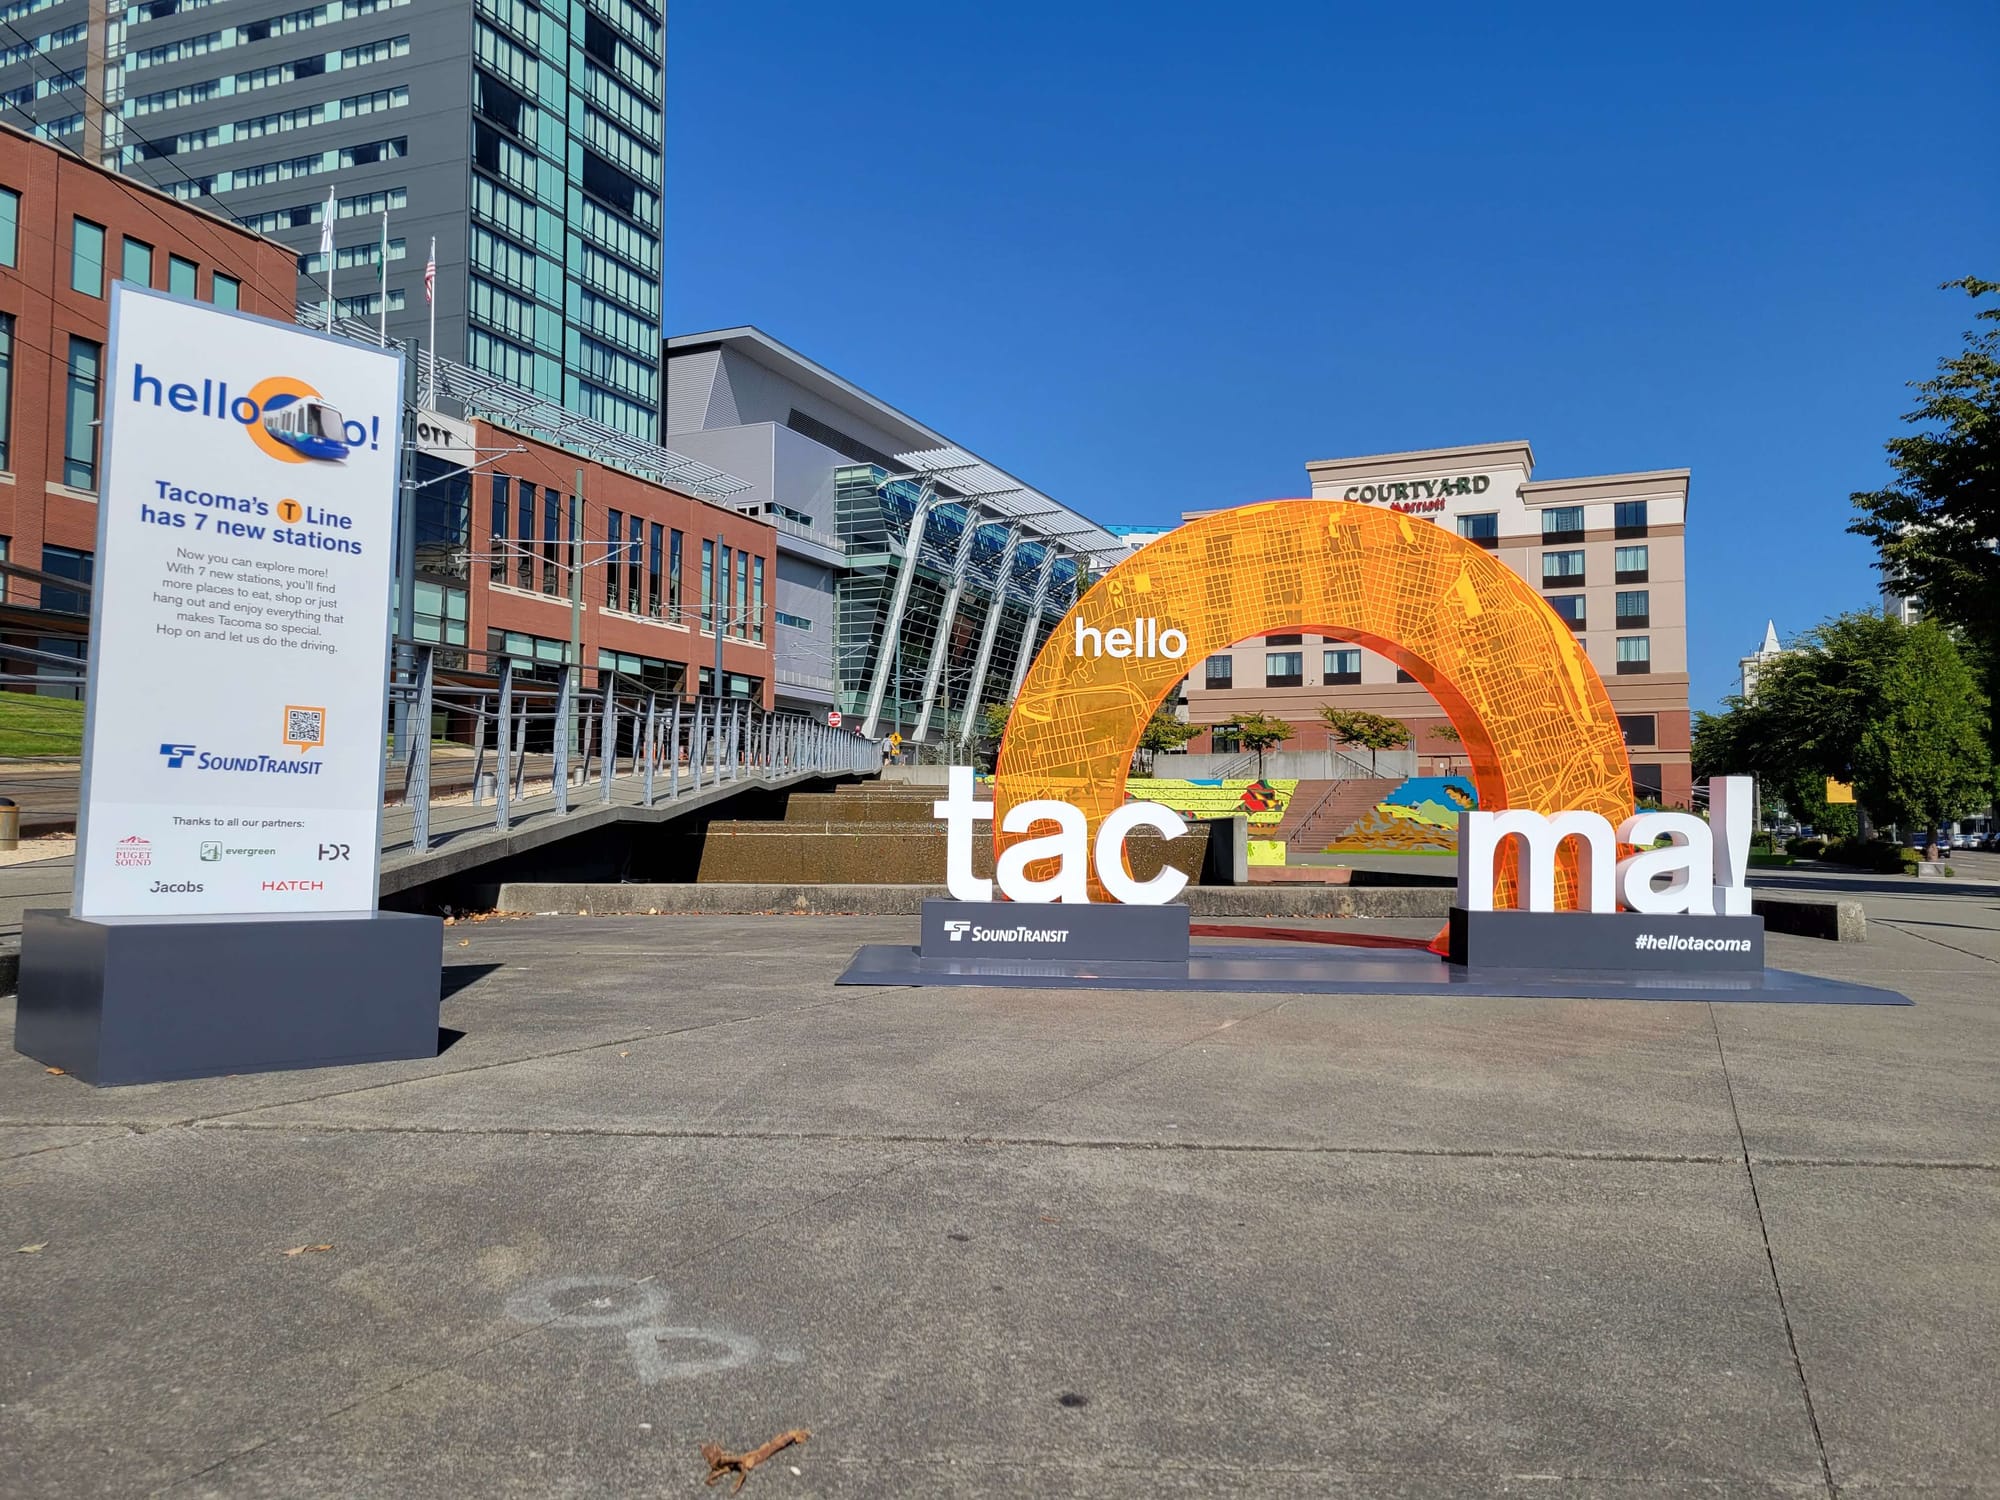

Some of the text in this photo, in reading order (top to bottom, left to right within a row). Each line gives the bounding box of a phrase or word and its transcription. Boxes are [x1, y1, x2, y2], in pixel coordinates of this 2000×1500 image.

[133, 363, 260, 425] hello
[1344, 475, 1490, 503] COURTYARD
[155, 480, 352, 529] Tacoma's T Line
[141, 504, 362, 555] has 7 new stations
[177, 547, 328, 578] Now you can explore more!
[167, 561, 336, 594] With 7 new stations, you'll find
[153, 591, 344, 624] hang out and enjoy everything that
[162, 580, 337, 609] more places to eat, shop or just
[156, 623, 338, 654] Hop on and let us do the driving.
[177, 612, 322, 636] makes Tacoma so special.
[1075, 617, 1187, 659] hello
[173, 816, 305, 828] Thanks to all our partners:
[934, 766, 1189, 905] tac
[116, 851, 152, 859] PUGET
[225, 848, 276, 857] evergreen
[318, 844, 350, 861] HDR
[150, 881, 204, 893] Jacobs
[262, 881, 323, 891] HATCH
[1635, 934, 1751, 952] #hellotacoma
